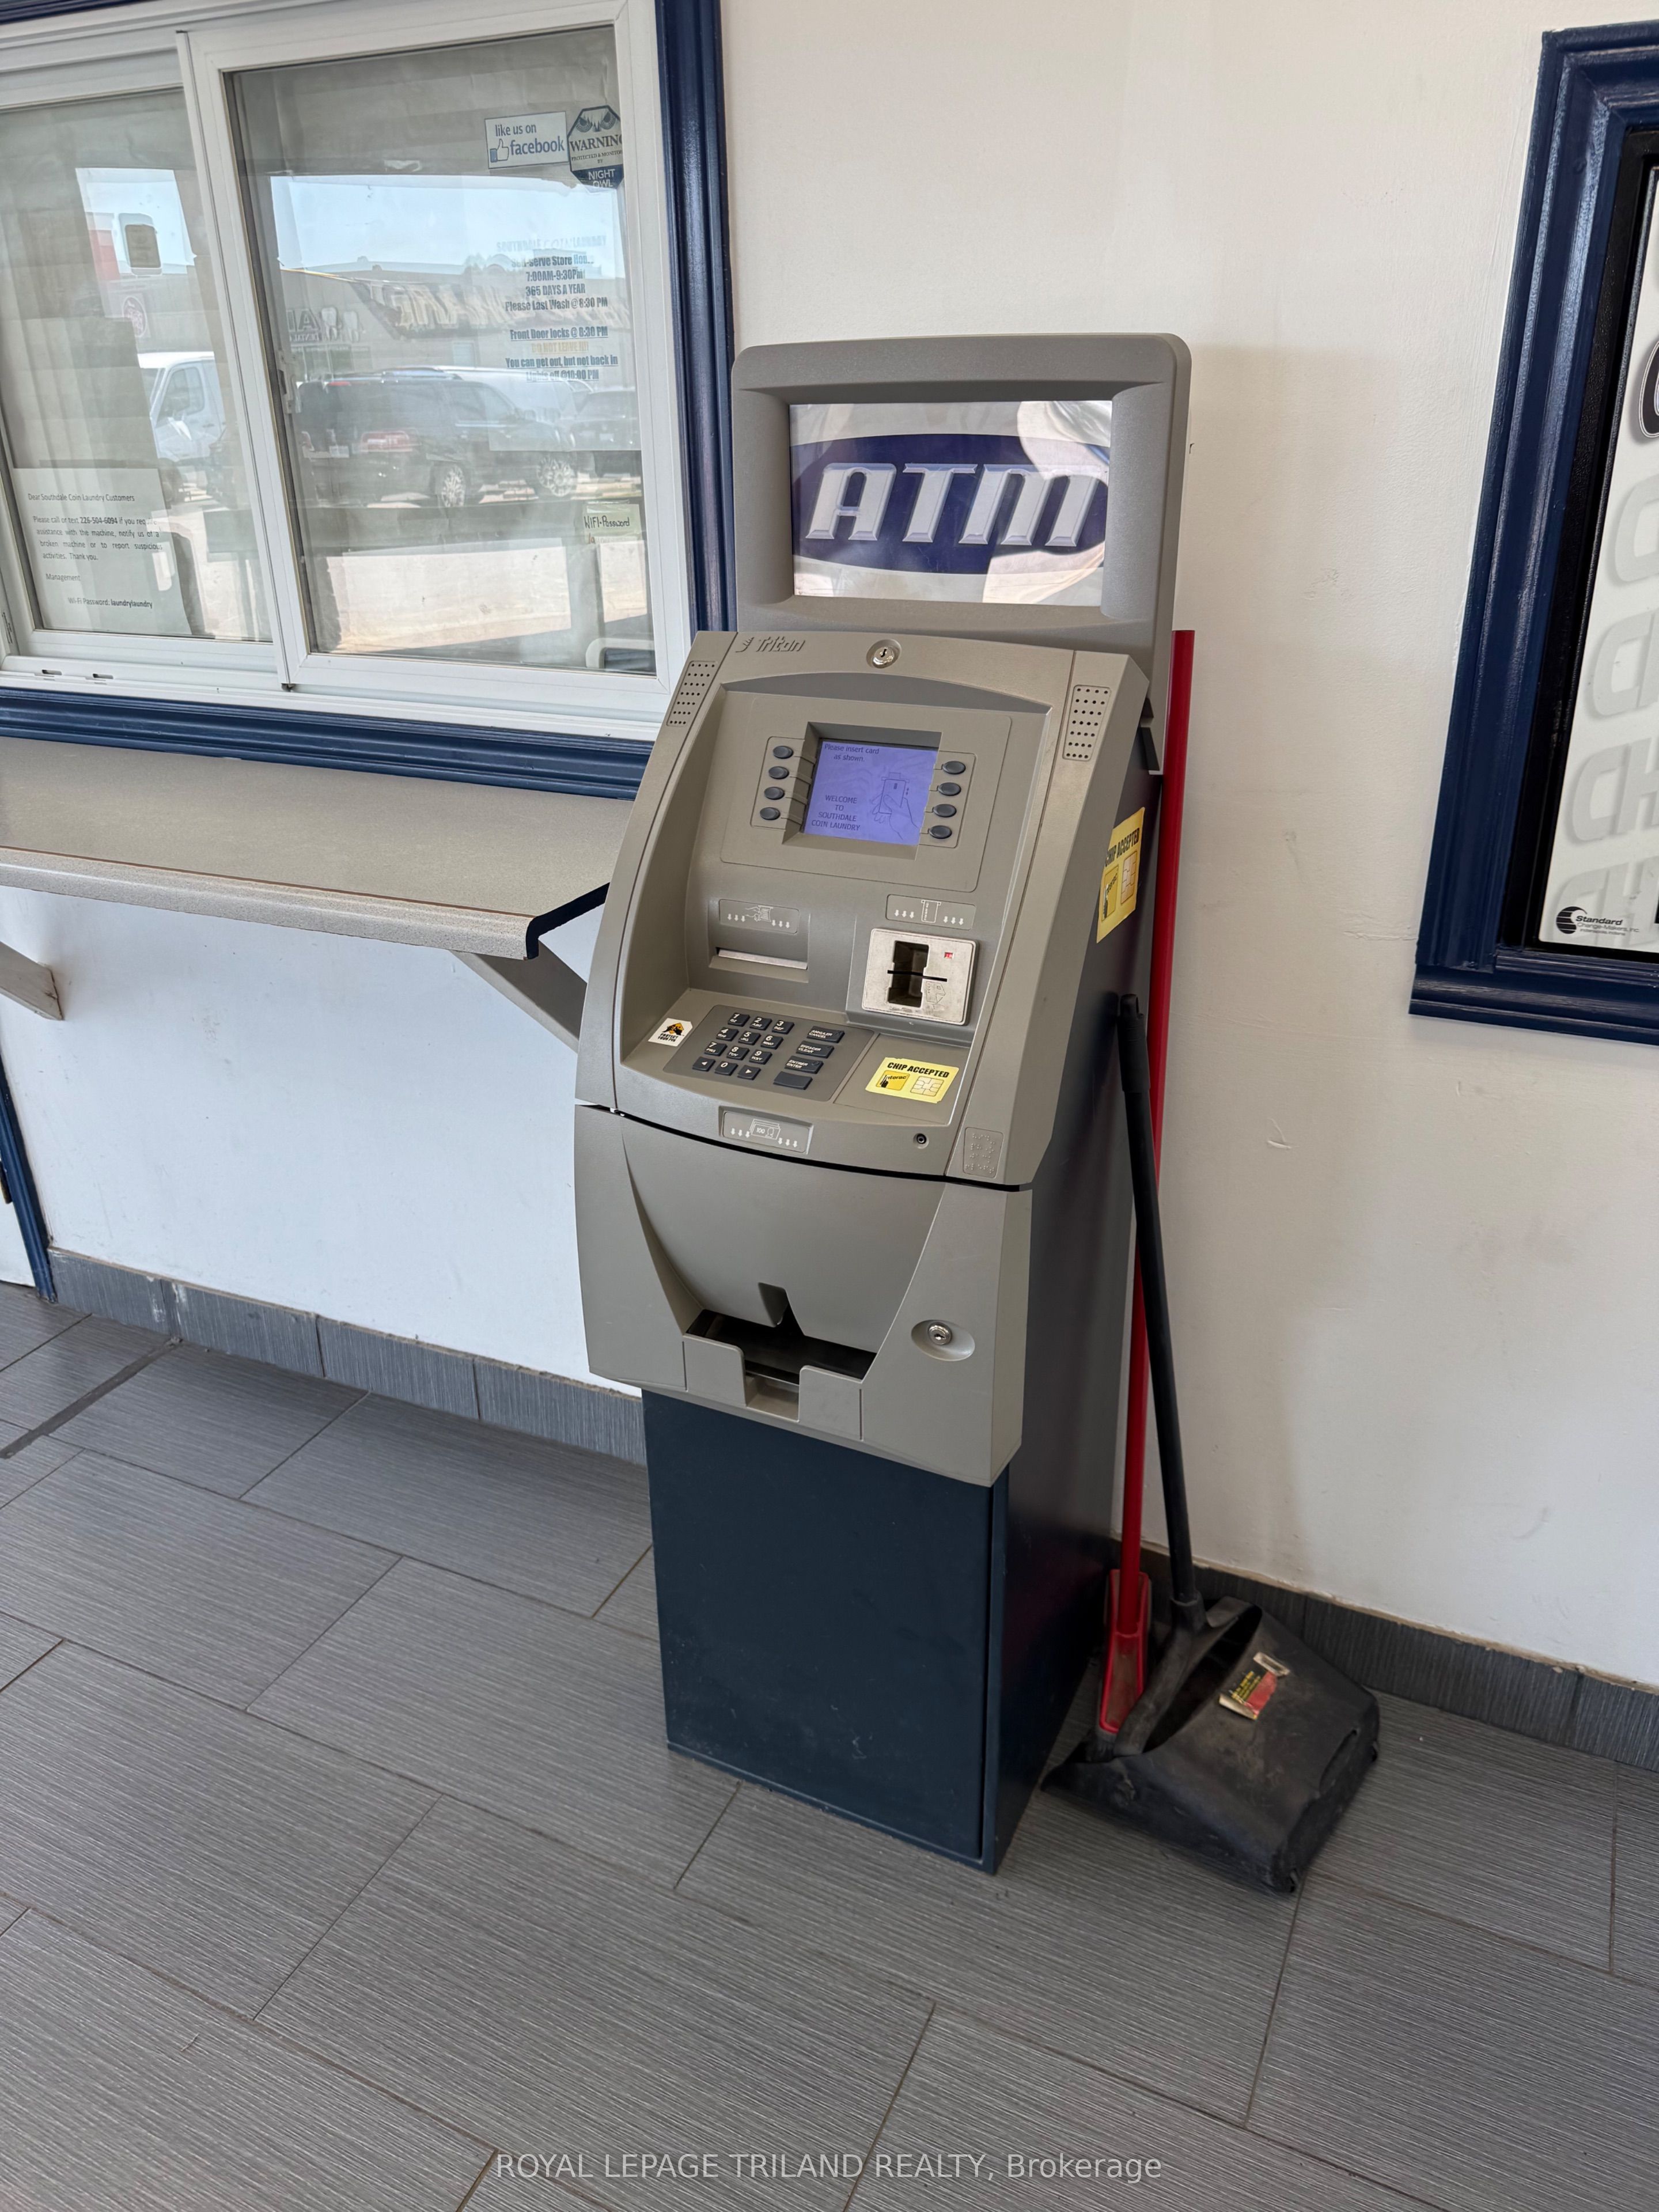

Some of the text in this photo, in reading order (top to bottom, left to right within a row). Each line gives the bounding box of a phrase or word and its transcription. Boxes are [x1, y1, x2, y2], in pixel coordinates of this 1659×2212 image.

[495, 124, 536, 137] like us on
[510, 135, 565, 156] facebook
[588, 168, 615, 180] NIGHT
[593, 179, 613, 187] OWL
[552, 256, 573, 266] Store
[573, 254, 594, 264] Hou
[526, 283, 586, 297] 365 DAYS A YEAR
[505, 297, 608, 312] Please Last Wash @ 8:30 PM
[510, 326, 608, 340] Front Door locks @ 8:30 PM
[505, 358, 520, 368] You
[521, 358, 535, 368] can
[536, 357, 548, 368] get
[549, 356, 563, 368] out,
[563, 355, 576, 366] but
[577, 355, 589, 366] not
[590, 354, 609, 365] back
[588, 369, 599, 380] PM
[805, 463, 1108, 547] ATM
[92, 529, 116, 537] machine,
[119, 530, 135, 538] notify
[46, 573, 81, 582] Management
[83, 598, 111, 606] Password:
[111, 599, 153, 609] laundrylaundry
[756, 636, 805, 652] Triton
[824, 743, 844, 751] Please
[825, 795, 857, 804] WELCOME
[818, 812, 857, 821] SOUTHDALE
[830, 821, 860, 831] LAUNDRY
[1117, 828, 1139, 858] ACCEPTED
[1575, 915, 1623, 925] Standard
[887, 1062, 950, 1078] CHIP ACCEPTED
